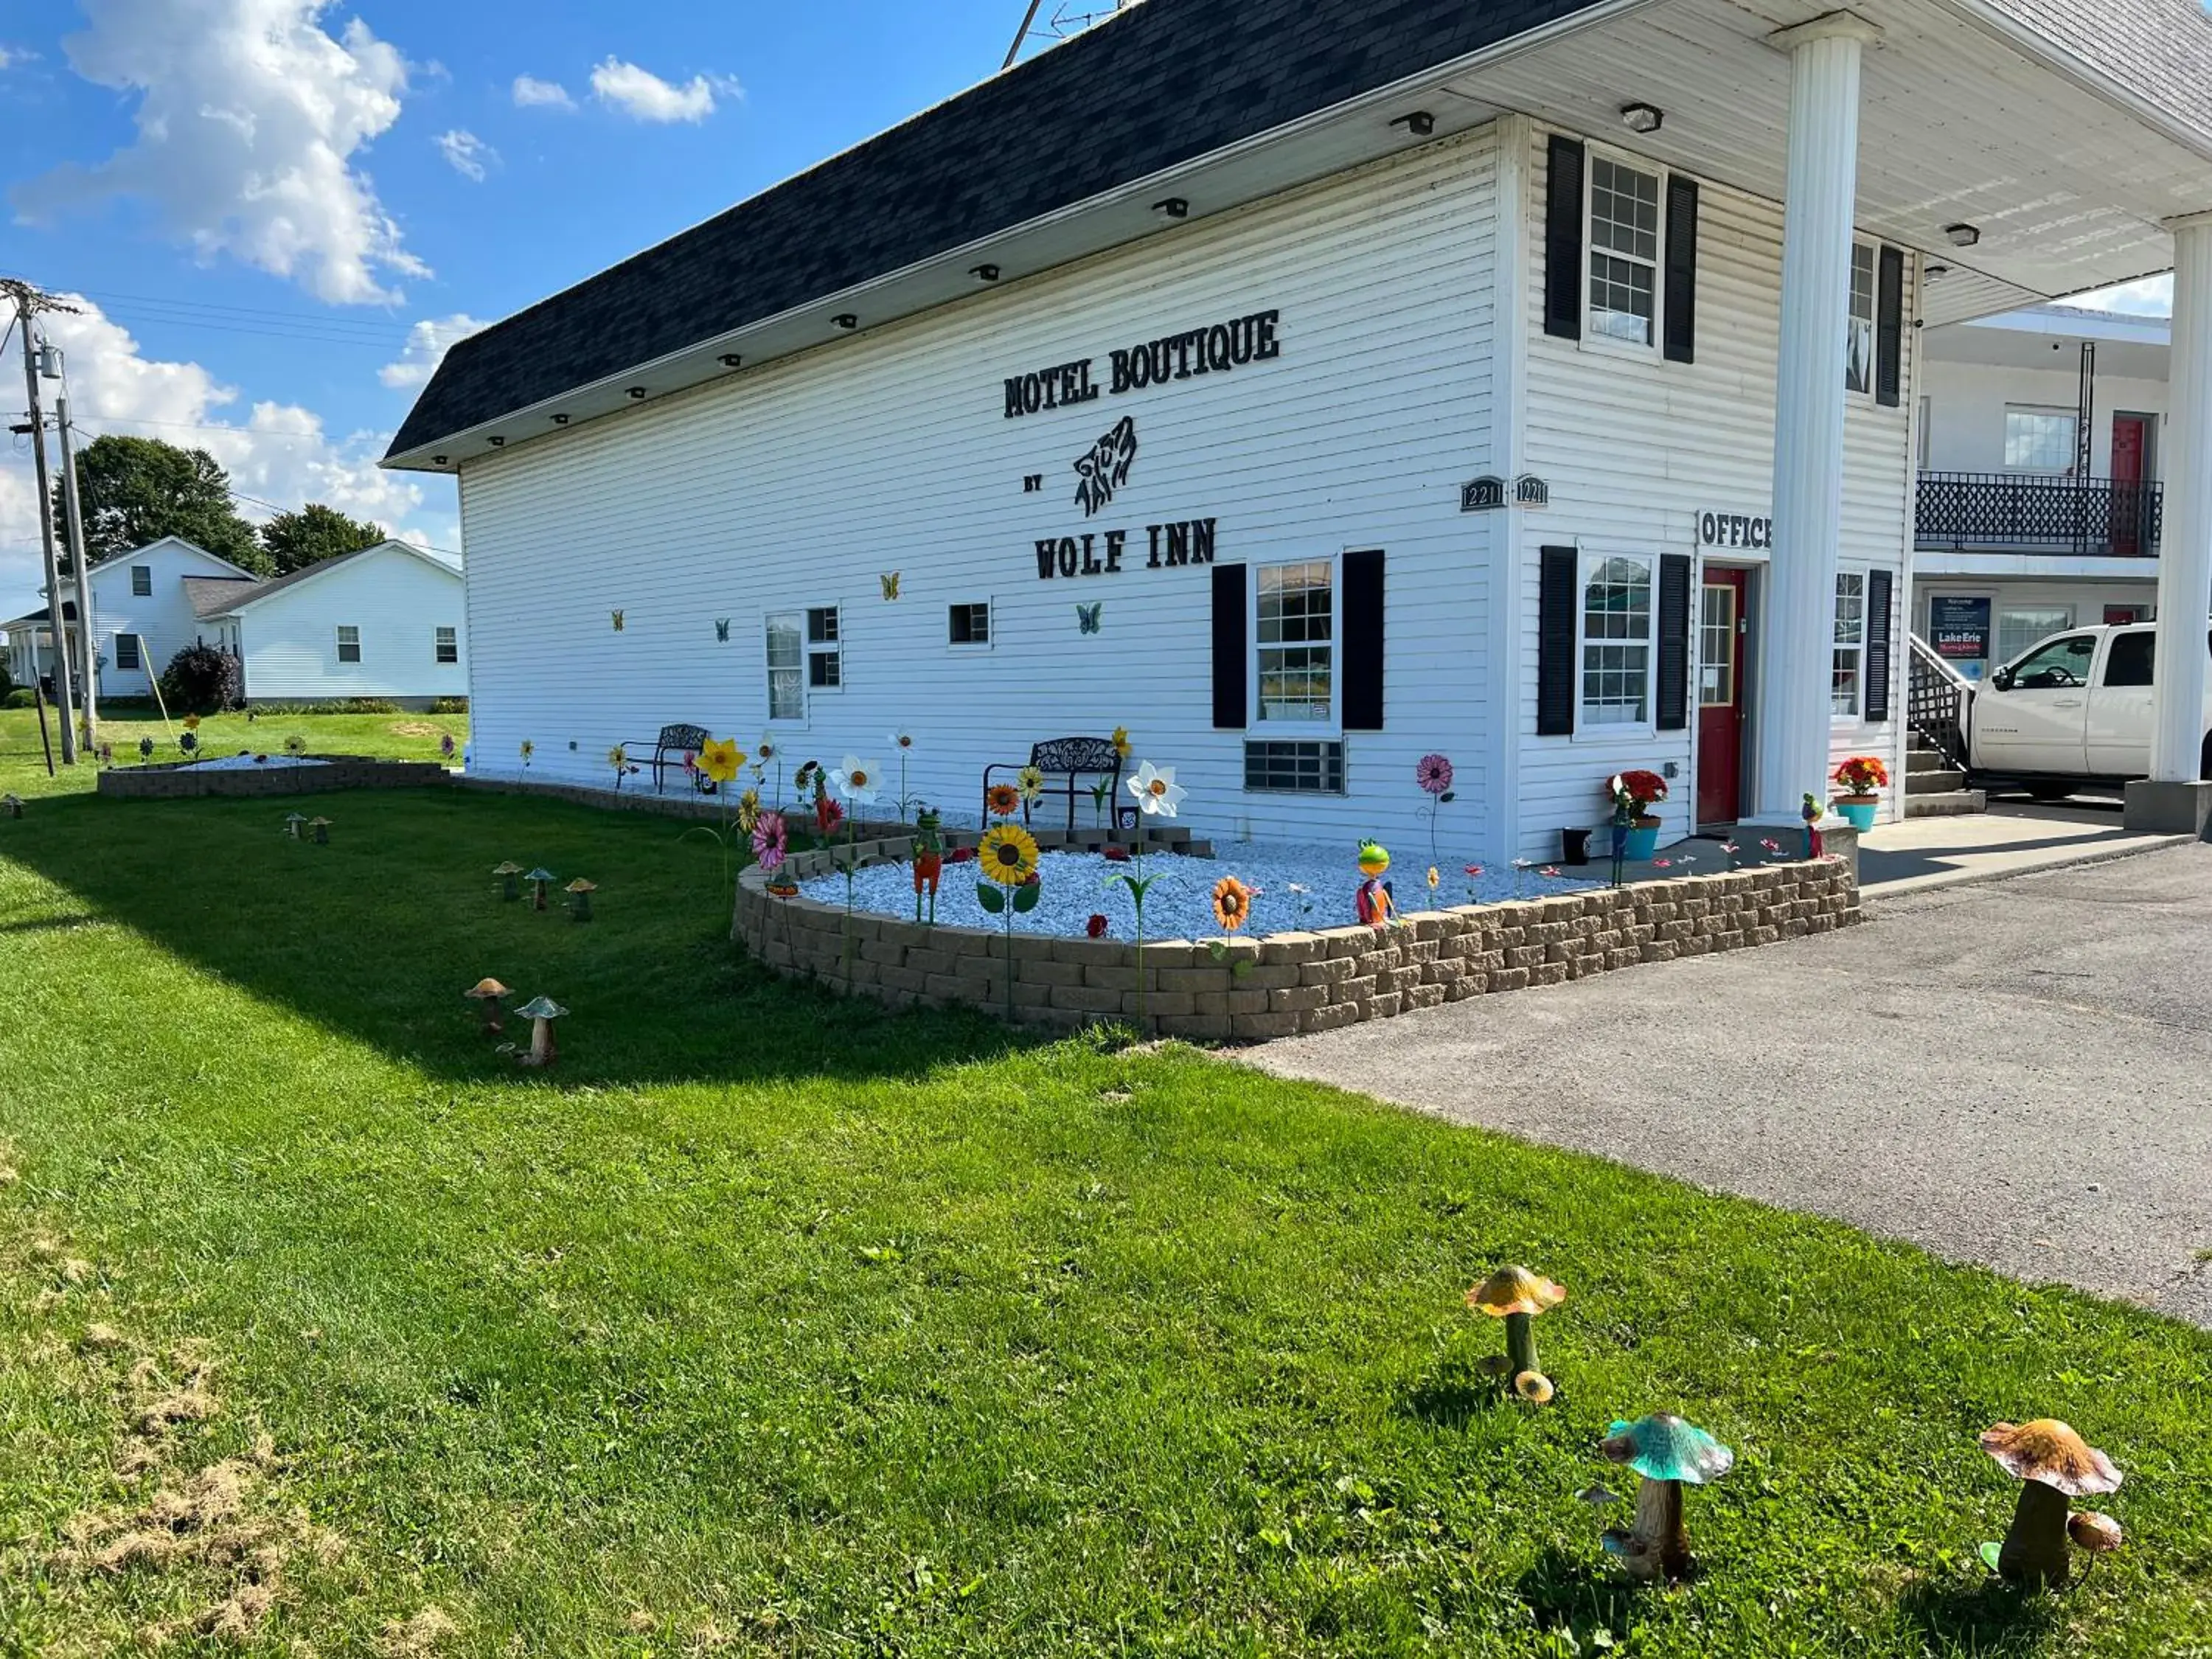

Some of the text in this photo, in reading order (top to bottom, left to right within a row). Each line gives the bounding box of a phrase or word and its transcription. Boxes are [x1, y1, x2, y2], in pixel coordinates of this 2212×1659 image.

[1004, 309, 1279, 417] MOTEL BOUTIQUE
[1023, 474, 1042, 493] BY
[1034, 518, 1216, 579] WOLF INN
